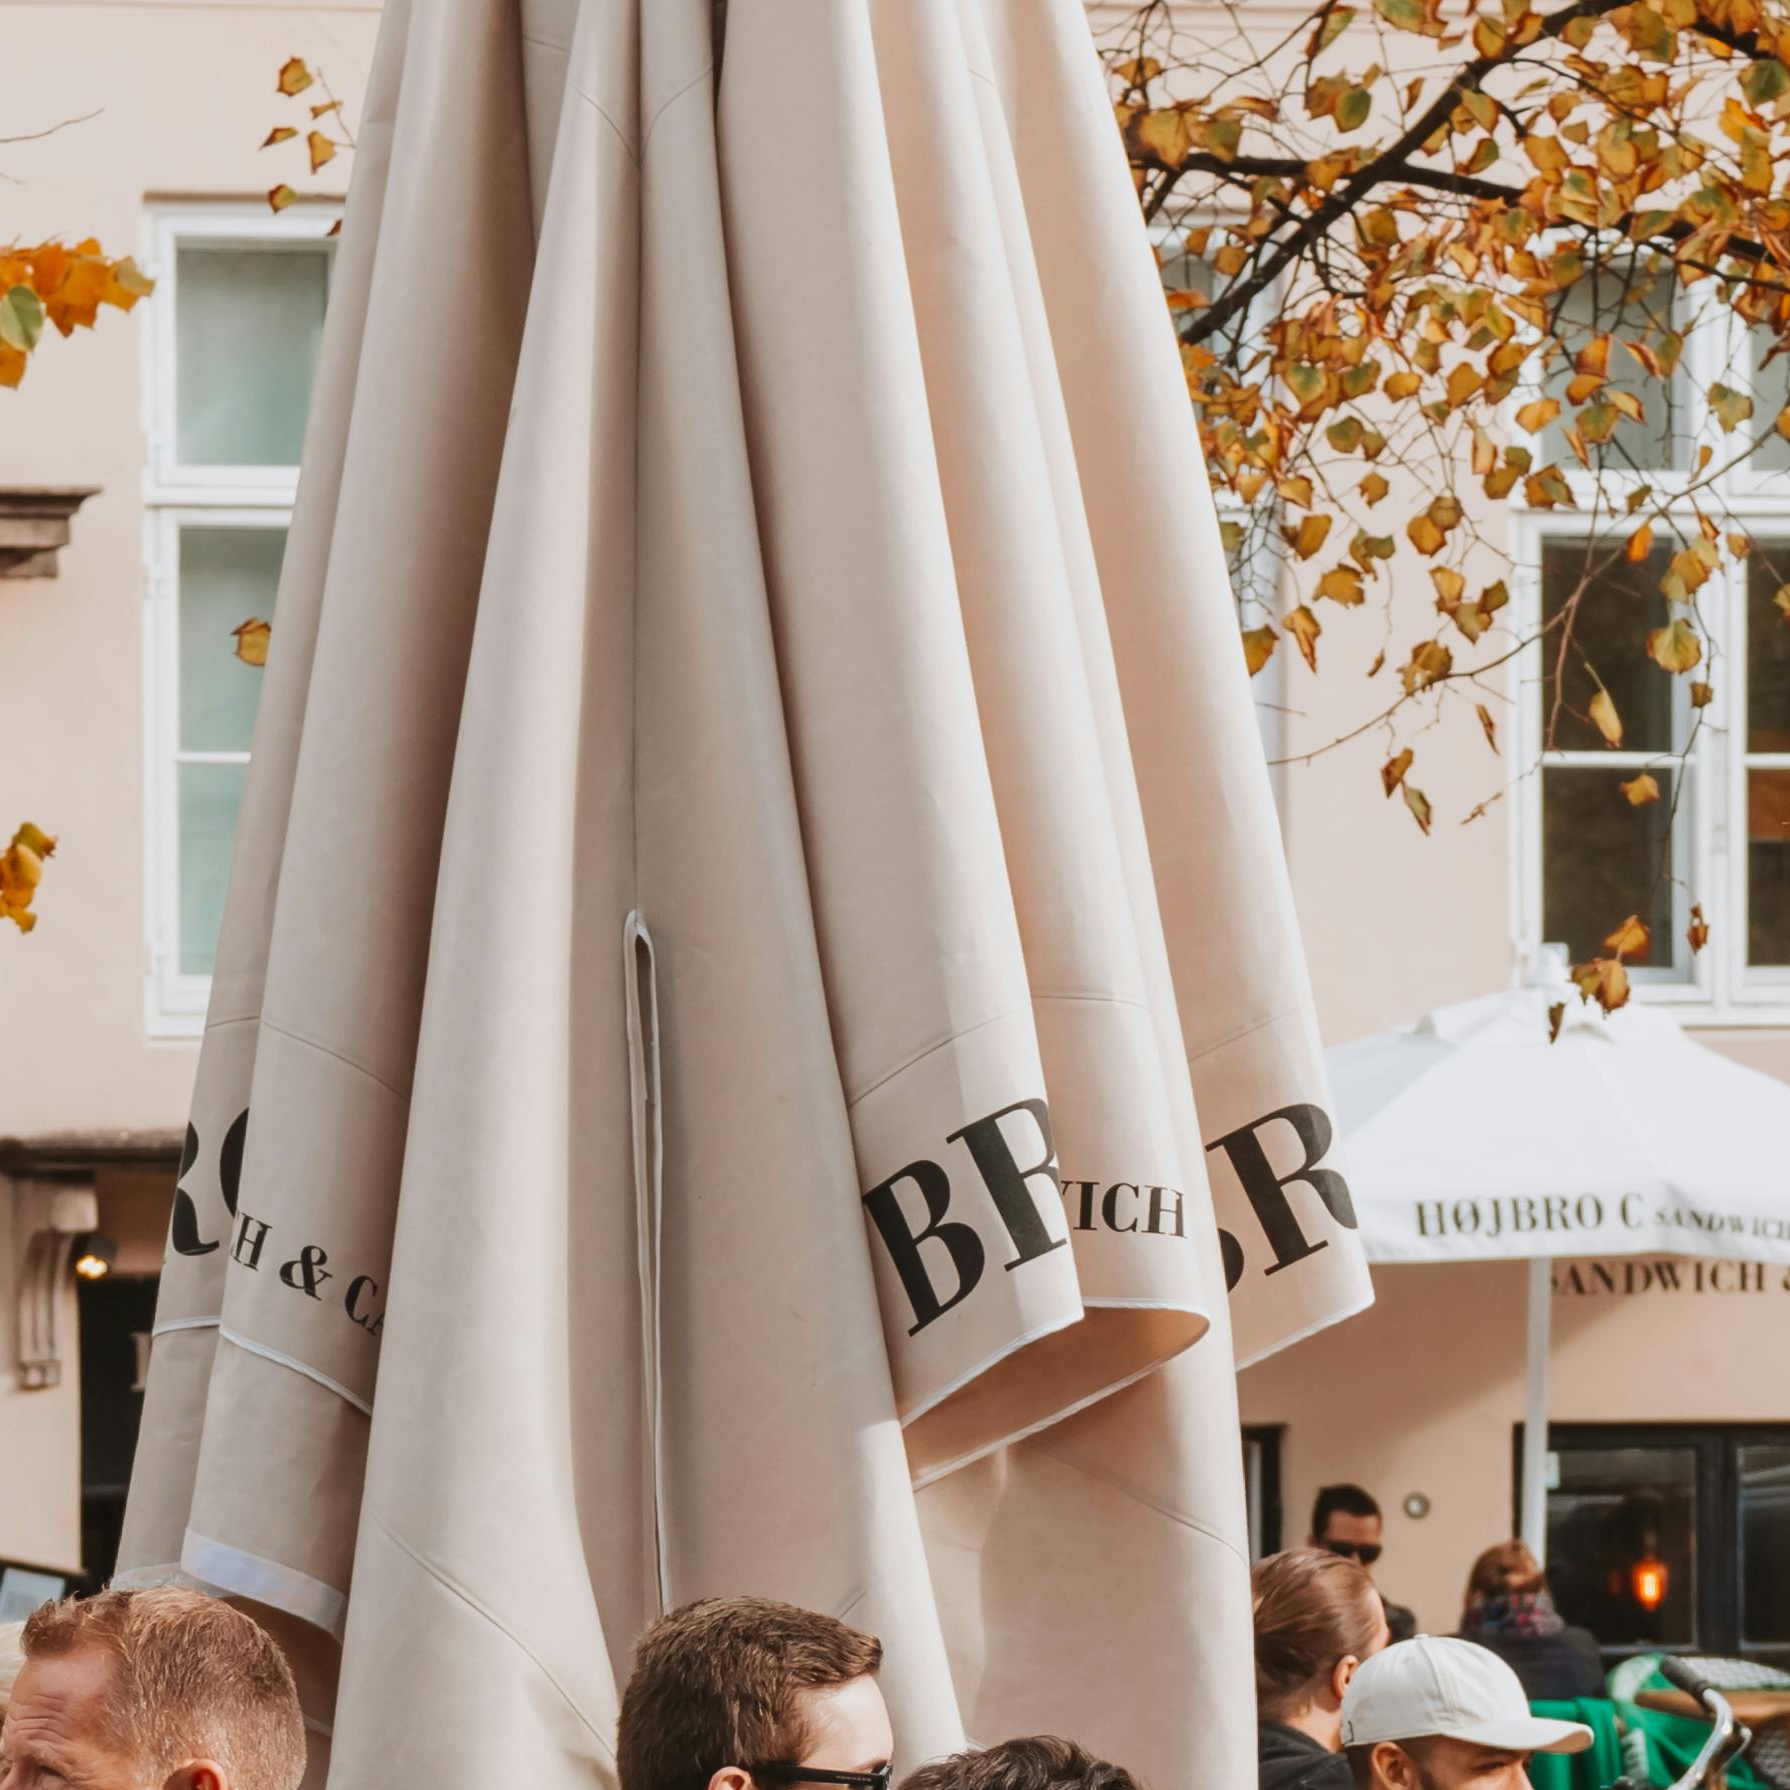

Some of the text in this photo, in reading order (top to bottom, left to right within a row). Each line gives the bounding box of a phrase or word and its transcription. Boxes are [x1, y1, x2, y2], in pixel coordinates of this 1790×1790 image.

[1205, 1103, 1358, 1295] R
[1414, 1192, 1604, 1238] HØJBRO
[279, 1244, 333, 1302] &
